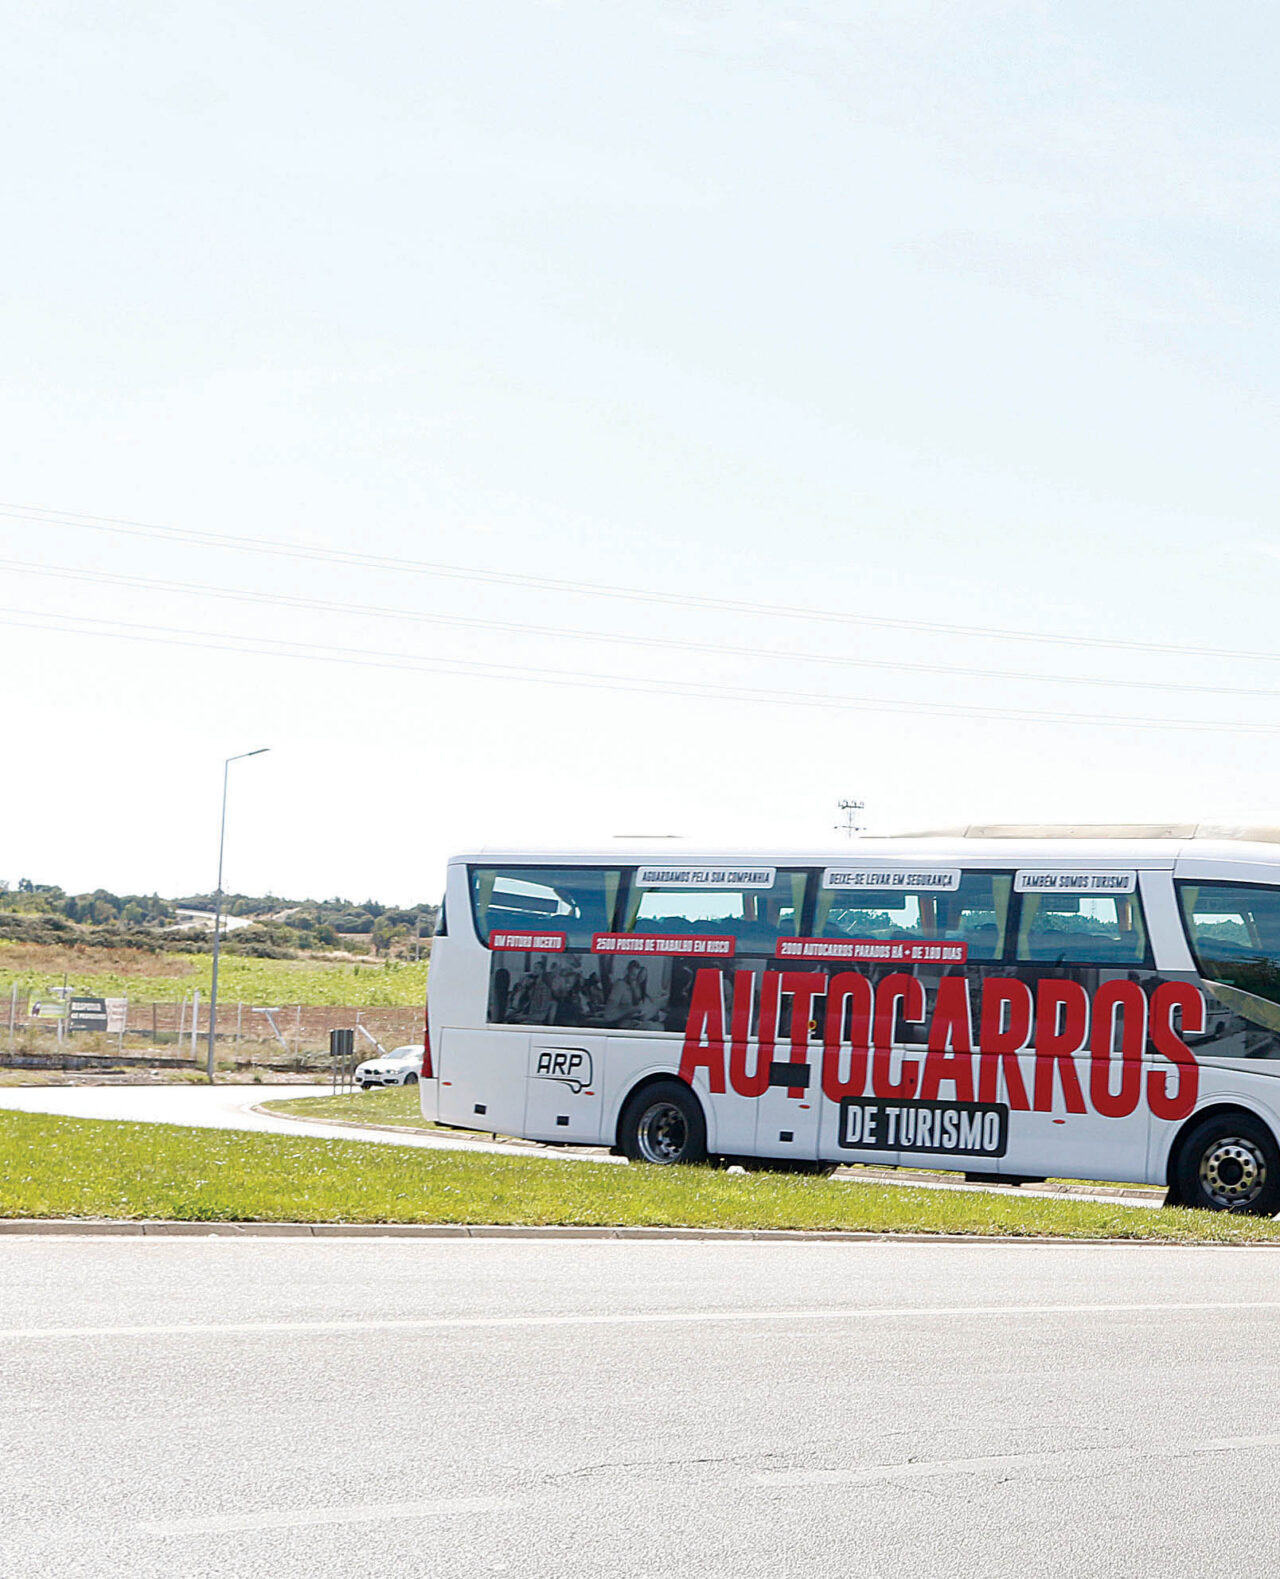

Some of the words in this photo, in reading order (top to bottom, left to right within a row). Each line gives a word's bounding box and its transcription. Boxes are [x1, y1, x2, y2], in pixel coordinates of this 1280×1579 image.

[642, 871, 690, 883] AGUARDAMOS
[691, 871, 709, 883] PELA
[711, 871, 726, 883] SUA
[727, 871, 770, 883] COMPANHIA
[829, 873, 866, 885] DEIXE-SE
[866, 873, 891, 885] LEVAR
[892, 873, 906, 885] EM
[906, 873, 953, 887] SEGURANÇA
[1022, 874, 1058, 888] TAMBÉM
[1059, 875, 1090, 888] SOMOS
[1091, 876, 1130, 888] TURISMO
[494, 935, 506, 946] UM
[506, 935, 533, 947] FUTURO
[533, 936, 562, 948] INCERTO
[596, 938, 616, 950] 2500
[616, 938, 644, 951] POSTOS
[644, 939, 656, 951] DE
[656, 939, 693, 952] TRABALHO
[693, 940, 706, 952] EM
[706, 940, 730, 953] RISCO
[781, 942, 803, 955] 2000
[803, 943, 853, 957] AUTOCARROS
[854, 944, 891, 958] PARADOS
[891, 944, 903, 958] HÁ
[911, 946, 923, 959] DE
[942, 947, 963, 960] DIAS
[680, 968, 1205, 1121] AUTOCARROS
[536, 1052, 583, 1075] ARP
[846, 1104, 878, 1146] DE
[885, 1106, 1001, 1151] TURISMO
